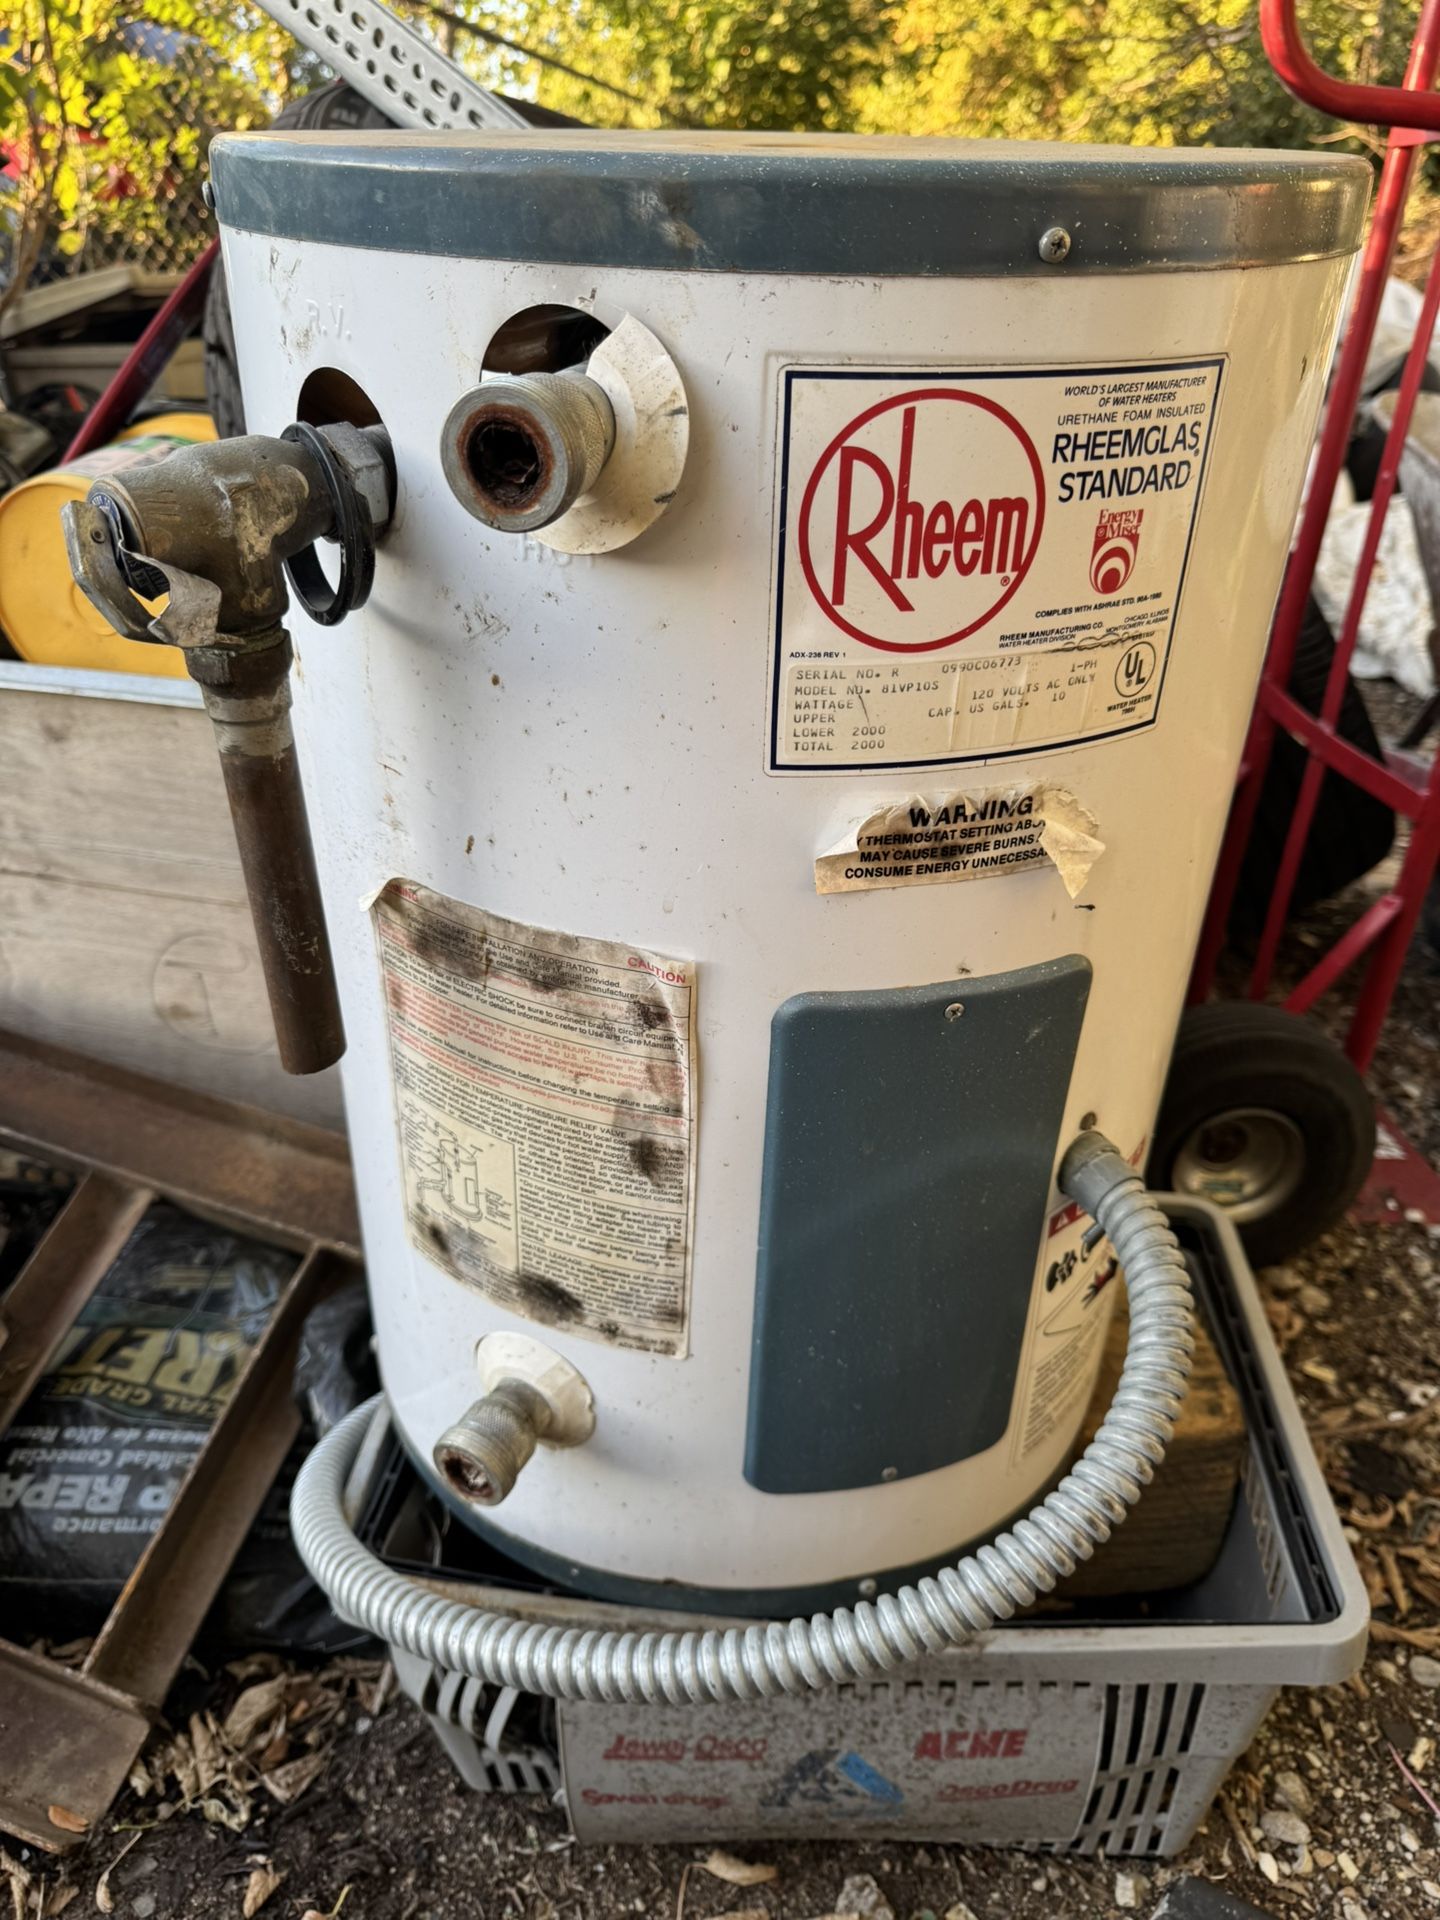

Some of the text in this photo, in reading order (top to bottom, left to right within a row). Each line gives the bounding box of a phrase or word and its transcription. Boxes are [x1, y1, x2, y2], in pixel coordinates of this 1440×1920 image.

[1064, 376, 1207, 397] WORLD'S LARGEST MANUFACTURER
[1099, 391, 1177, 408] OF WATER HEATERS
[1057, 402, 1206, 426] URETHANE FOAM INSULATED
[1058, 459, 1192, 503] STANDARD
[831, 406, 1029, 612] Rheem
[1098, 508, 1139, 525] Energy
[1035, 606, 1073, 618] COMPLIES
[1074, 604, 1093, 613] WITH
[1093, 599, 1120, 610] ASHRAE
[999, 633, 1076, 649] WATER HEATER DIVISION
[1000, 621, 1104, 642] RHEEM MANUFACTURING CO.
[823, 651, 840, 659] REV
[796, 669, 848, 681] SERIAL
[856, 668, 881, 680] NO.
[891, 668, 901, 678] R
[1124, 651, 1146, 686] UL
[794, 686, 837, 696] MODEL
[846, 684, 871, 696] NO.
[972, 673, 1097, 700] 120 VOLTS AC ONLY
[795, 700, 854, 710] WATTAGE
[927, 691, 1066, 718] CAP. US GALS. 10
[1107, 694, 1152, 713] WATER HEATER
[793, 713, 836, 724] UPPER
[793, 725, 886, 738] LOWER 2000
[794, 739, 885, 752] TOTAL 2000
[909, 796, 1034, 828] WARNING
[865, 829, 958, 846] THERMOSTAT
[960, 823, 1013, 839] SETTING
[860, 850, 893, 863] MAY
[893, 848, 939, 861] CAUSE
[941, 841, 991, 857] SEVERE
[993, 833, 1035, 850] BURNS
[845, 865, 914, 879] CONSUME
[916, 860, 970, 874] ENERGY
[498, 951, 513, 964] Use
[548, 957, 598, 975] OPERATION
[627, 957, 687, 984] CAUTION
[453, 977, 643, 1037] ELECTRIC be sure to connect branch circuit
[476, 994, 487, 1004] For
[488, 999, 516, 1015] detailed
[517, 1009, 558, 1028] information
[559, 1021, 578, 1032] refer
[579, 1026, 586, 1034] to
[588, 1027, 602, 1037] Use
[622, 1035, 642, 1045] Care
[518, 1069, 540, 1083] before
[542, 1078, 577, 1095] changing
[579, 1088, 591, 1097] the
[593, 1091, 640, 1109] temperature
[643, 1102, 670, 1114] setting
[570, 1119, 596, 1131] RELIEF
[600, 1127, 626, 1138] VALVE
[914, 1728, 1029, 1762] ACME
